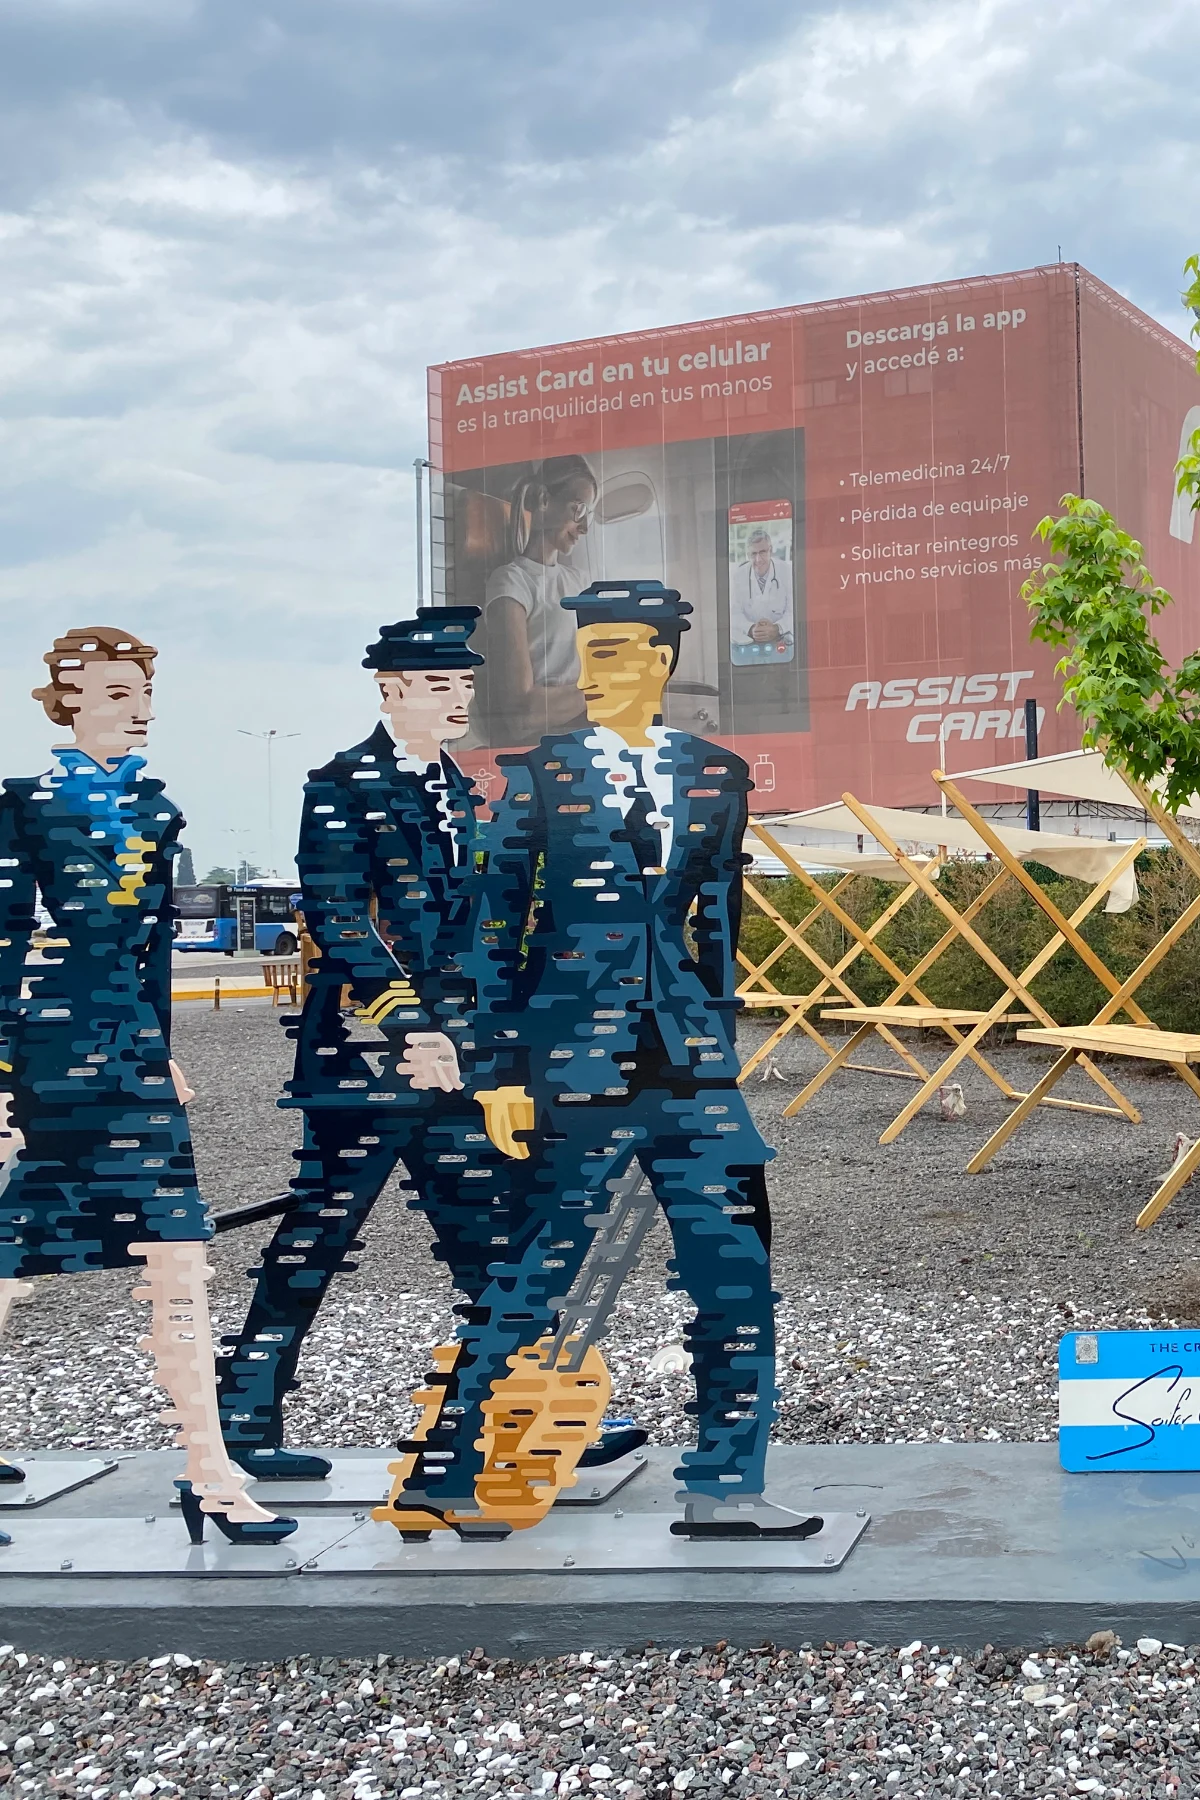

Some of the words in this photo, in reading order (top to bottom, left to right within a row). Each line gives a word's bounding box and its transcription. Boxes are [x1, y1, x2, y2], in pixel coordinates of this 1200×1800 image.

[846, 315, 949, 349] Descargá
[956, 313, 976, 332] la
[983, 308, 1027, 331] app
[456, 374, 528, 406] Assist
[535, 362, 594, 393] Card
[602, 363, 634, 383] en
[641, 354, 669, 377] tu
[678, 340, 772, 372] celular
[845, 361, 858, 381] y
[864, 345, 940, 374] accedé
[946, 346, 965, 363] a:
[456, 416, 477, 433] es
[482, 411, 498, 429] la
[503, 391, 624, 427] tranquilidad
[629, 390, 655, 408] en
[661, 383, 694, 404] tus
[700, 374, 773, 399] manos
[849, 461, 965, 488] Telemedicina
[970, 453, 1011, 475] 24/7
[851, 503, 917, 525] Pérdida
[922, 501, 945, 517] de
[950, 492, 1029, 517] equipaje
[851, 541, 921, 562] Solicitar
[926, 533, 1019, 555] reintegros
[839, 572, 850, 590] y
[855, 565, 916, 585] mucho
[920, 559, 999, 580] servicios
[1004, 553, 1042, 572] más
[844, 670, 1035, 711] ASSIST
[906, 706, 1046, 743] CARD
[1149, 1342, 1179, 1353] THE
